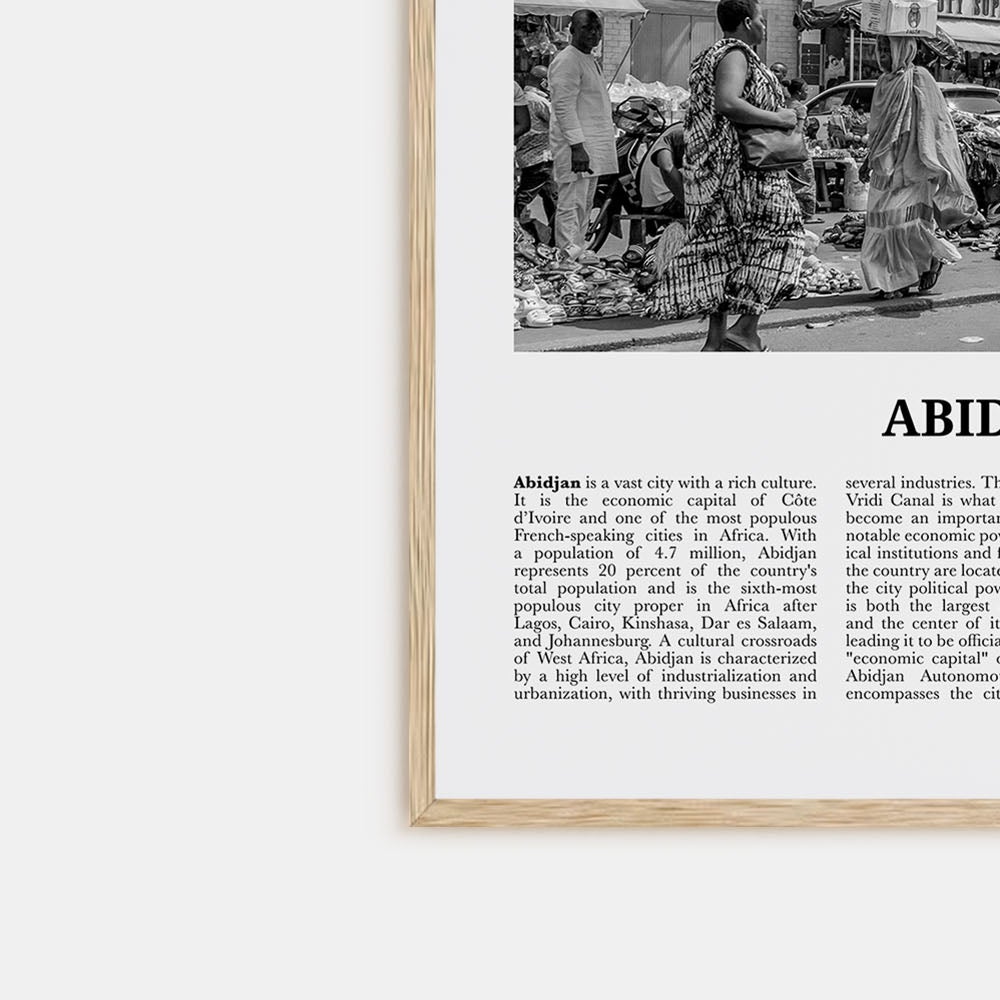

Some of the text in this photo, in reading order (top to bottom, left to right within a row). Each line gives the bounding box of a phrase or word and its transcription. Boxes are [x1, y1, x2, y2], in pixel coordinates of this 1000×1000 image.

[513, 475, 817, 492] Abidjan is a vast city with a rich culture.
[845, 475, 896, 488] several
[900, 475, 976, 488] industries.
[514, 492, 817, 510] It is the economic capital of Côte
[845, 493, 883, 506] Vridi
[890, 493, 935, 506] Canal
[942, 493, 953, 506] is
[959, 493, 996, 506] what
[514, 528, 817, 545] French-speaking cities in Africa. With
[513, 545, 817, 562] a population of 4.7 million, Abidjan
[845, 545, 872, 558] ical
[877, 545, 959, 558] institutions
[963, 545, 992, 558] and
[514, 581, 817, 598] total population and is the sixth-most
[514, 616, 817, 633] Lagos, Cairo, Kinshasa, Dar es Salaam,
[845, 616, 874, 629] and
[881, 616, 905, 629] the
[911, 618, 959, 629] center
[965, 616, 983, 629] of
[845, 668, 905, 685] Abidjan
[514, 686, 817, 703] urbanization, with thriving businesses in
[845, 690, 940, 703] encompasses
[950, 686, 973, 699] the
